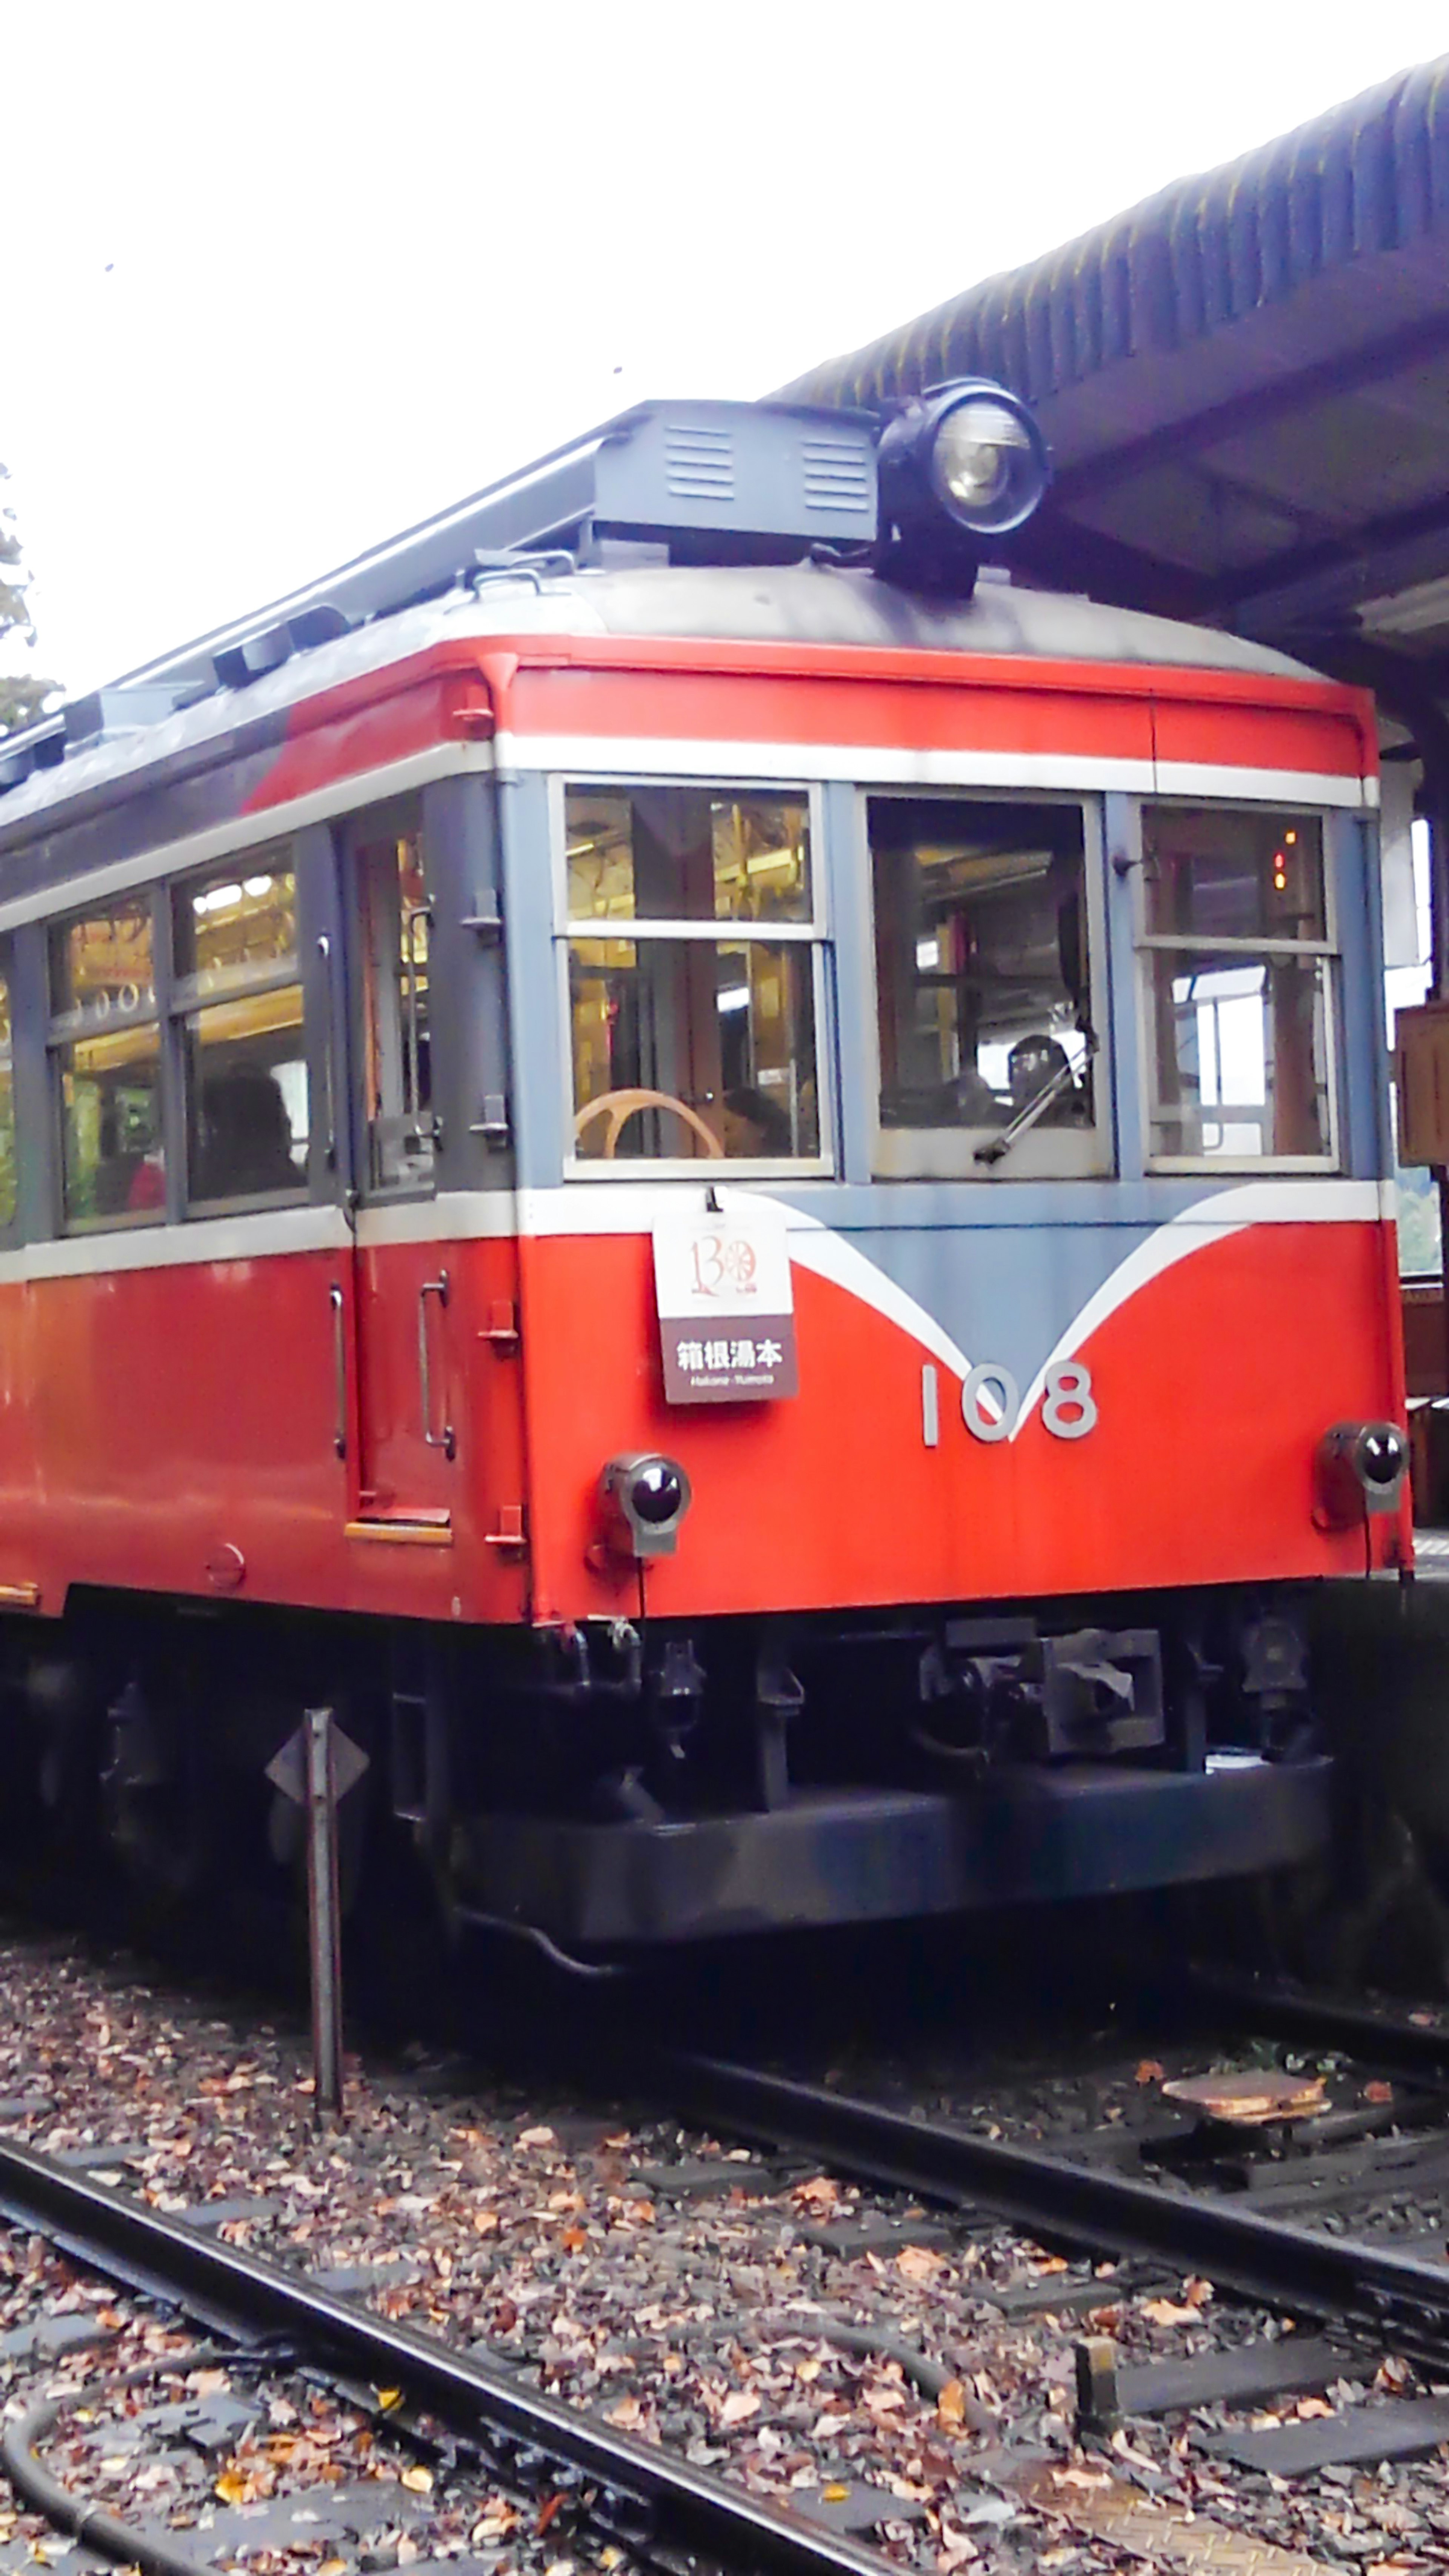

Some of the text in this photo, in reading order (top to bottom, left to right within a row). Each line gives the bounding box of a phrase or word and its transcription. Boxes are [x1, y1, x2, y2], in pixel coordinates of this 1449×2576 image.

[677, 1339, 783, 1370] 箱根湯本
[922, 1361, 1097, 1447] 108
